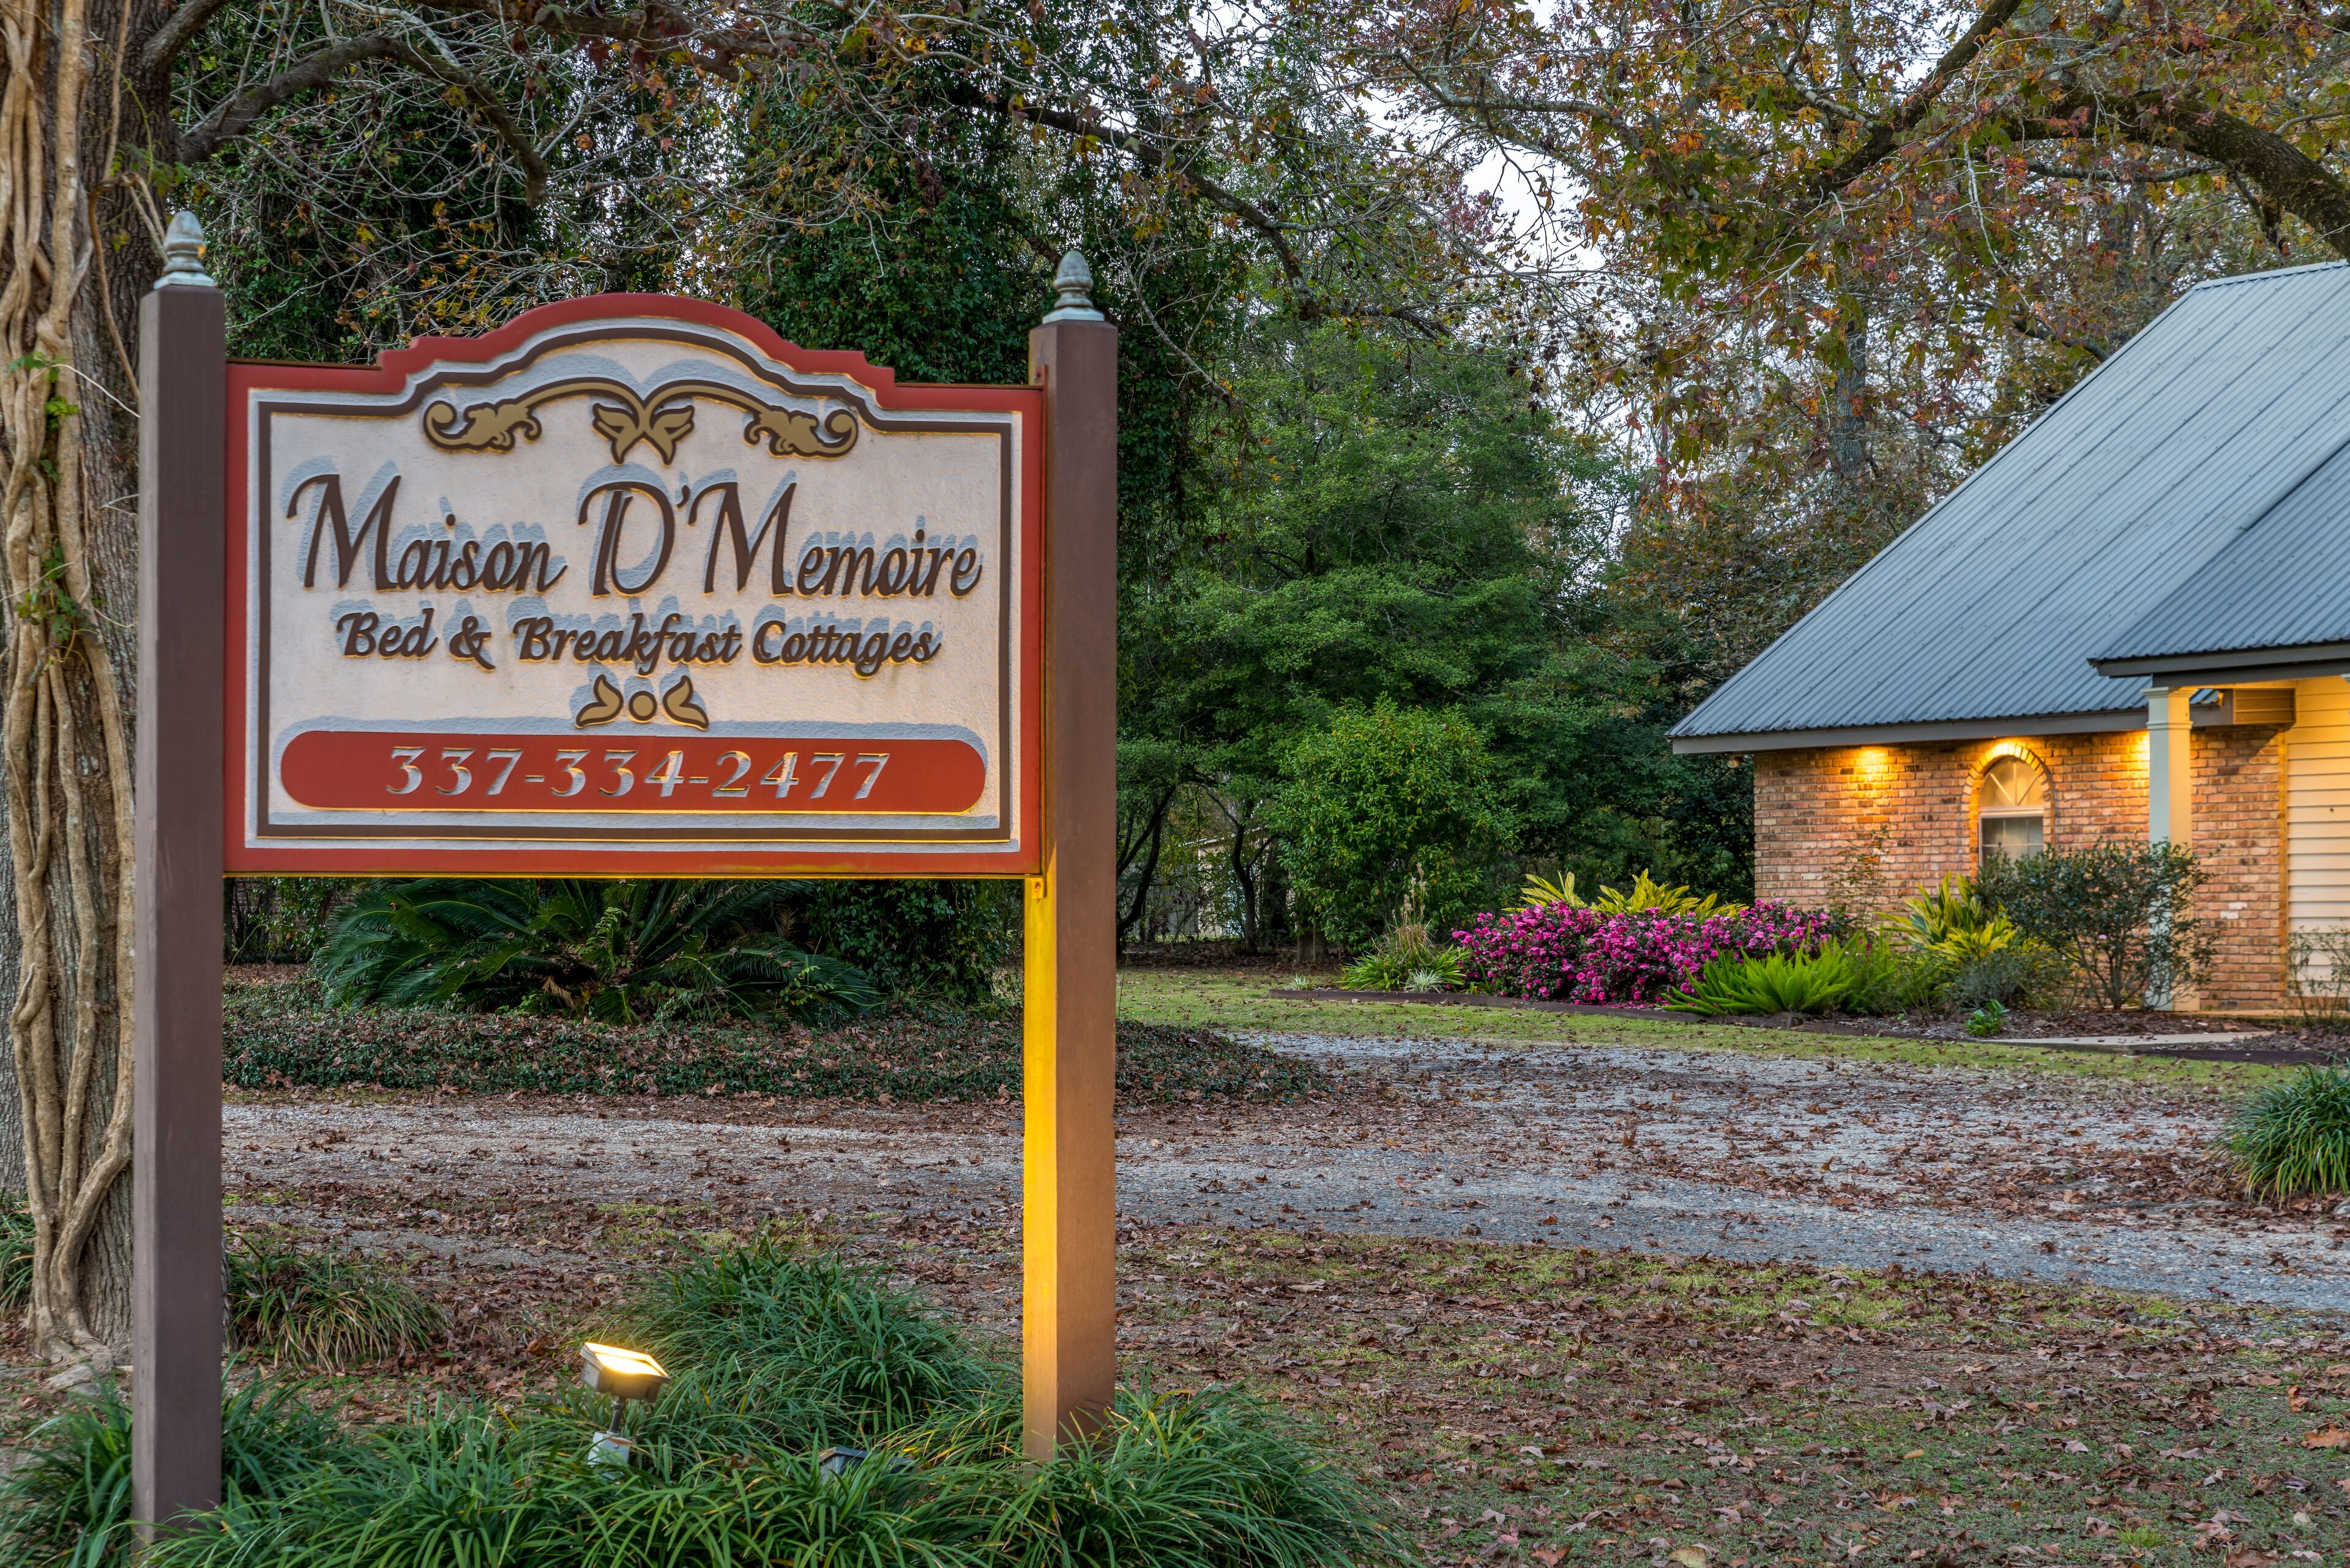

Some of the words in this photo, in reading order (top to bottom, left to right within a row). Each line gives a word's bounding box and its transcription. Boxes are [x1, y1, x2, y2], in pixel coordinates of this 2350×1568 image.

[286, 474, 568, 594] Maison
[577, 480, 983, 597] D'Memoire
[336, 608, 438, 659] Bed
[449, 615, 496, 672] &
[512, 612, 742, 678] Breakfast
[752, 619, 941, 679] Cottages
[386, 745, 890, 799] 337-334-2477
